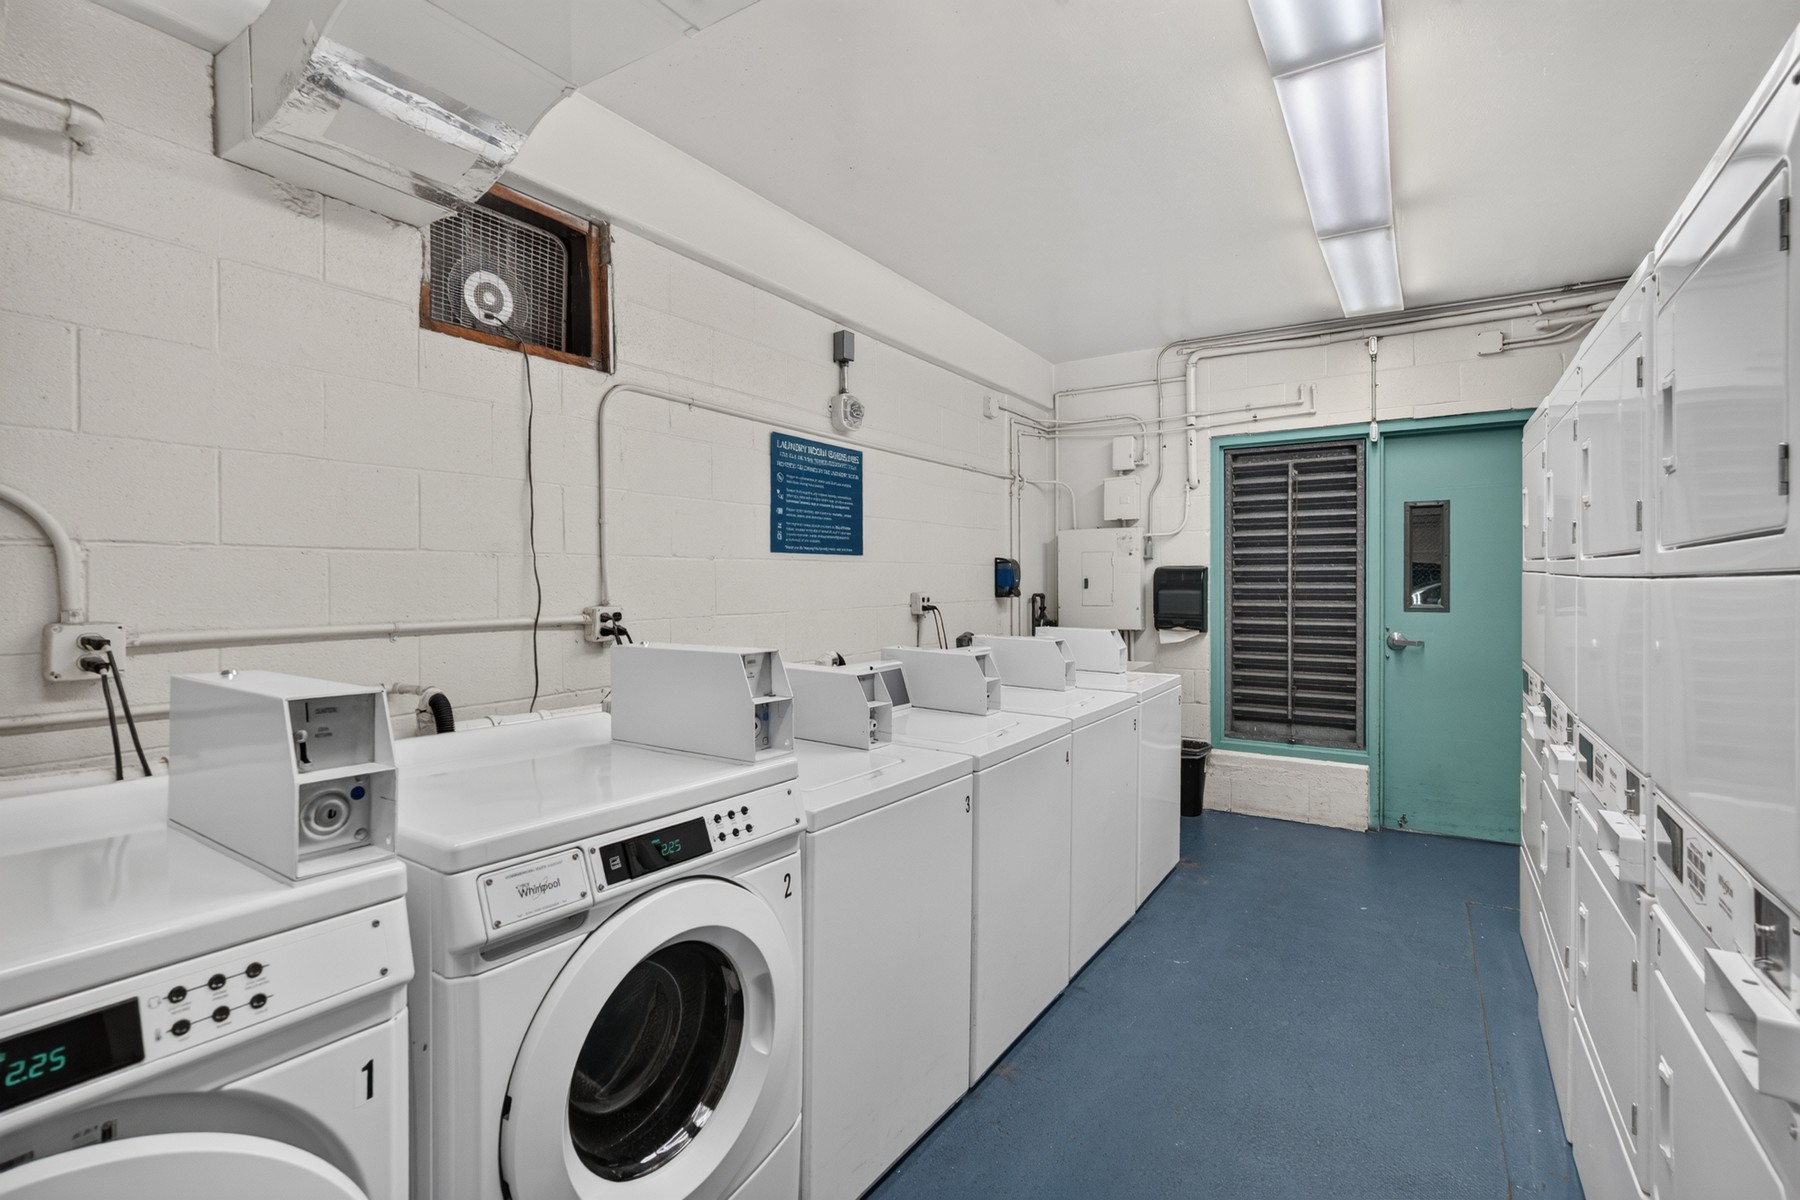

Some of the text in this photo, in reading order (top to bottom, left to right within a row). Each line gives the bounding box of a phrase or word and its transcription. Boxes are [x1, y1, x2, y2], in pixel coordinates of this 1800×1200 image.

[776, 439, 807, 454] LAUNDRY
[965, 795, 971, 813] 3
[661, 838, 682, 857] 2.25
[517, 877, 561, 899] Whirlpool
[783, 872, 792, 900] 2
[4, 1045, 67, 1087] 2.25
[361, 1058, 374, 1101] 1
